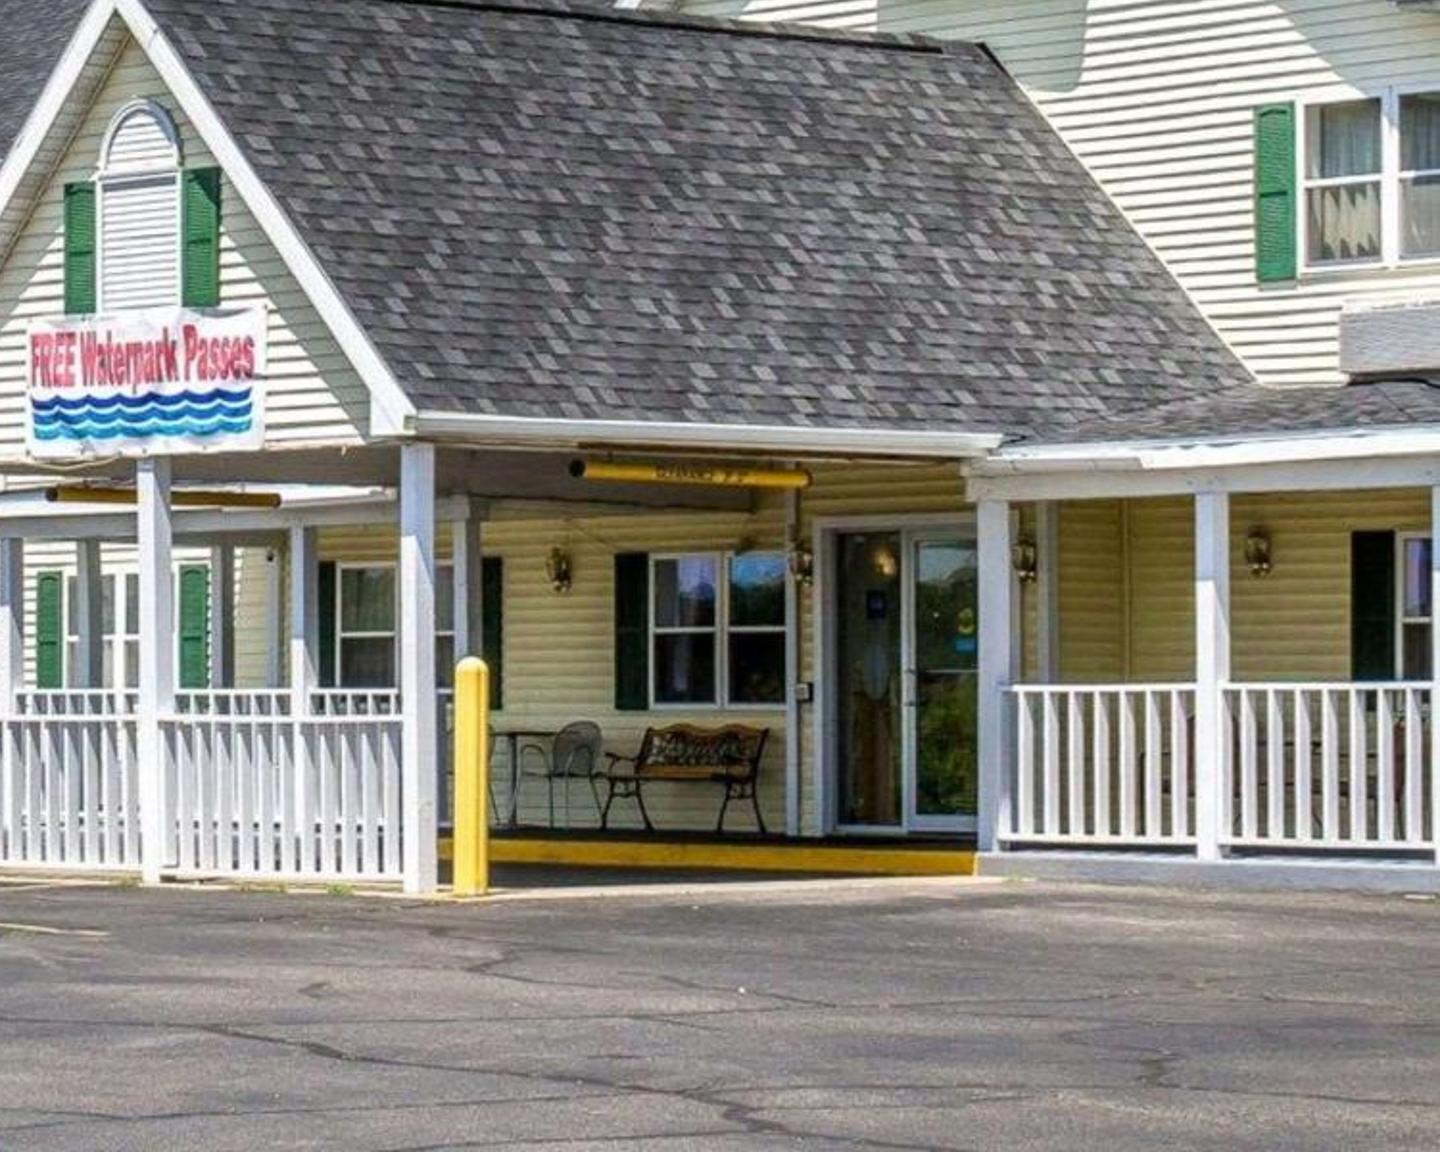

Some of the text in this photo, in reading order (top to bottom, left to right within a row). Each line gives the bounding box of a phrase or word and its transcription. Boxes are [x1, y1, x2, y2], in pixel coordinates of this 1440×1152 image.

[30, 323, 255, 395] FREE Waterpark Passes
